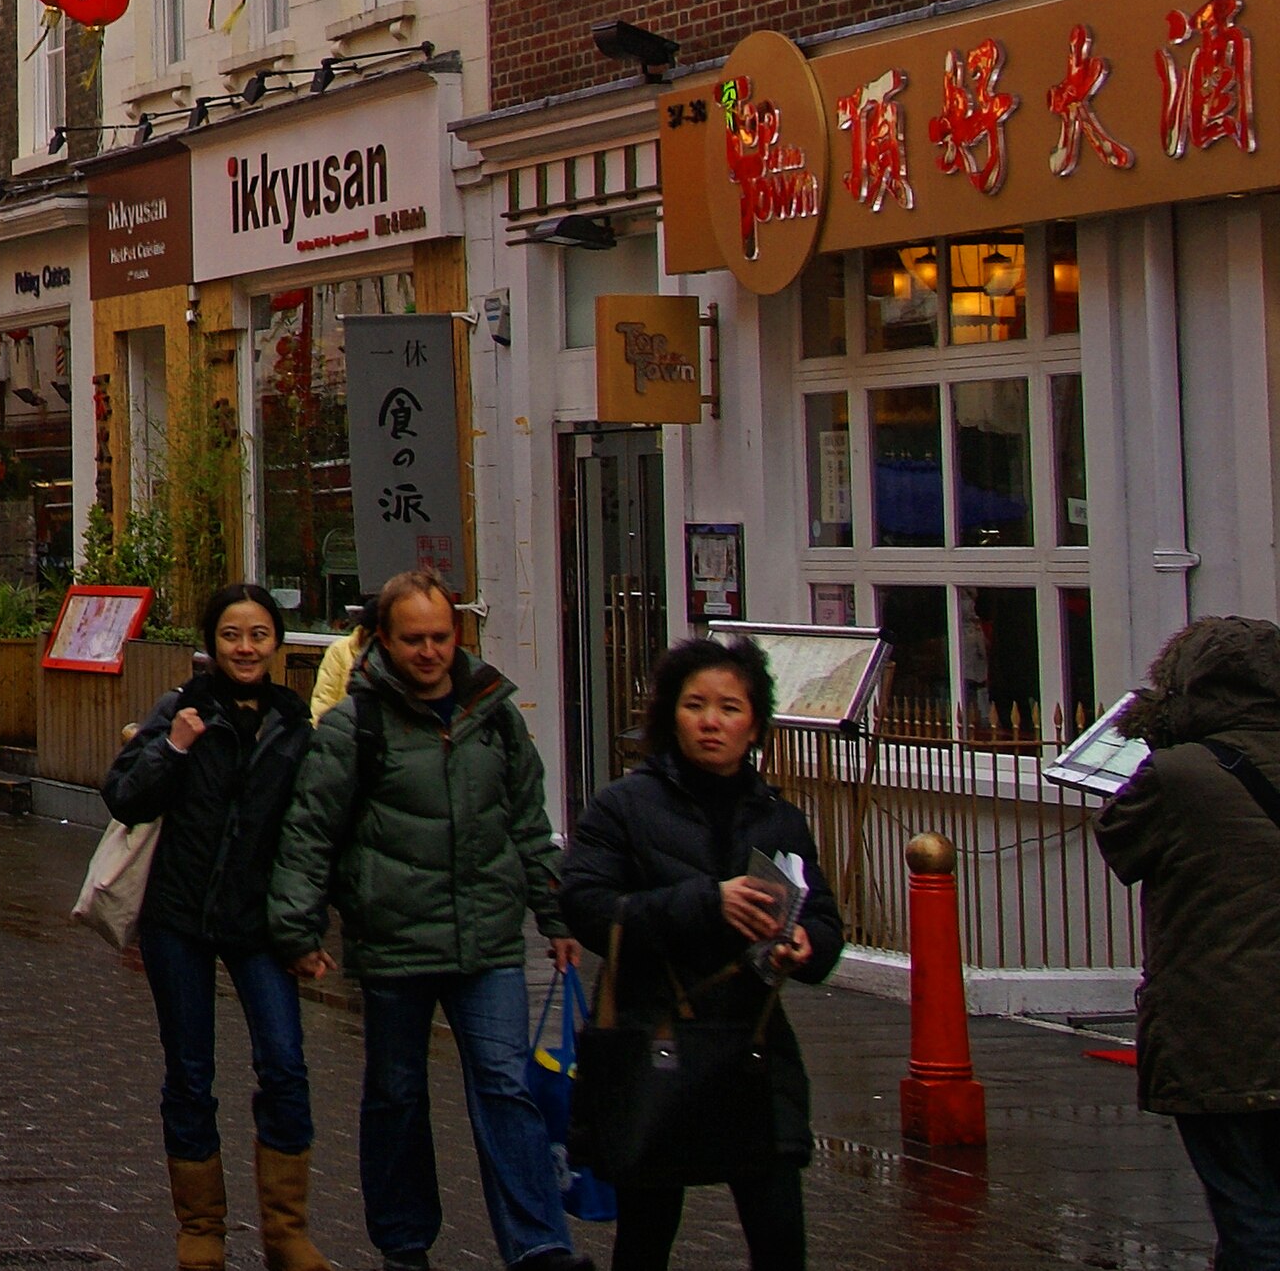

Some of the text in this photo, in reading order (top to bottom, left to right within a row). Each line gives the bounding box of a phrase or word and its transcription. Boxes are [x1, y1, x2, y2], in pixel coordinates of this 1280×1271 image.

[107, 196, 168, 235] ikkyusan
[227, 143, 388, 244] ikkyusan
[370, 339, 427, 367] 一休
[378, 386, 431, 524] 食の派
